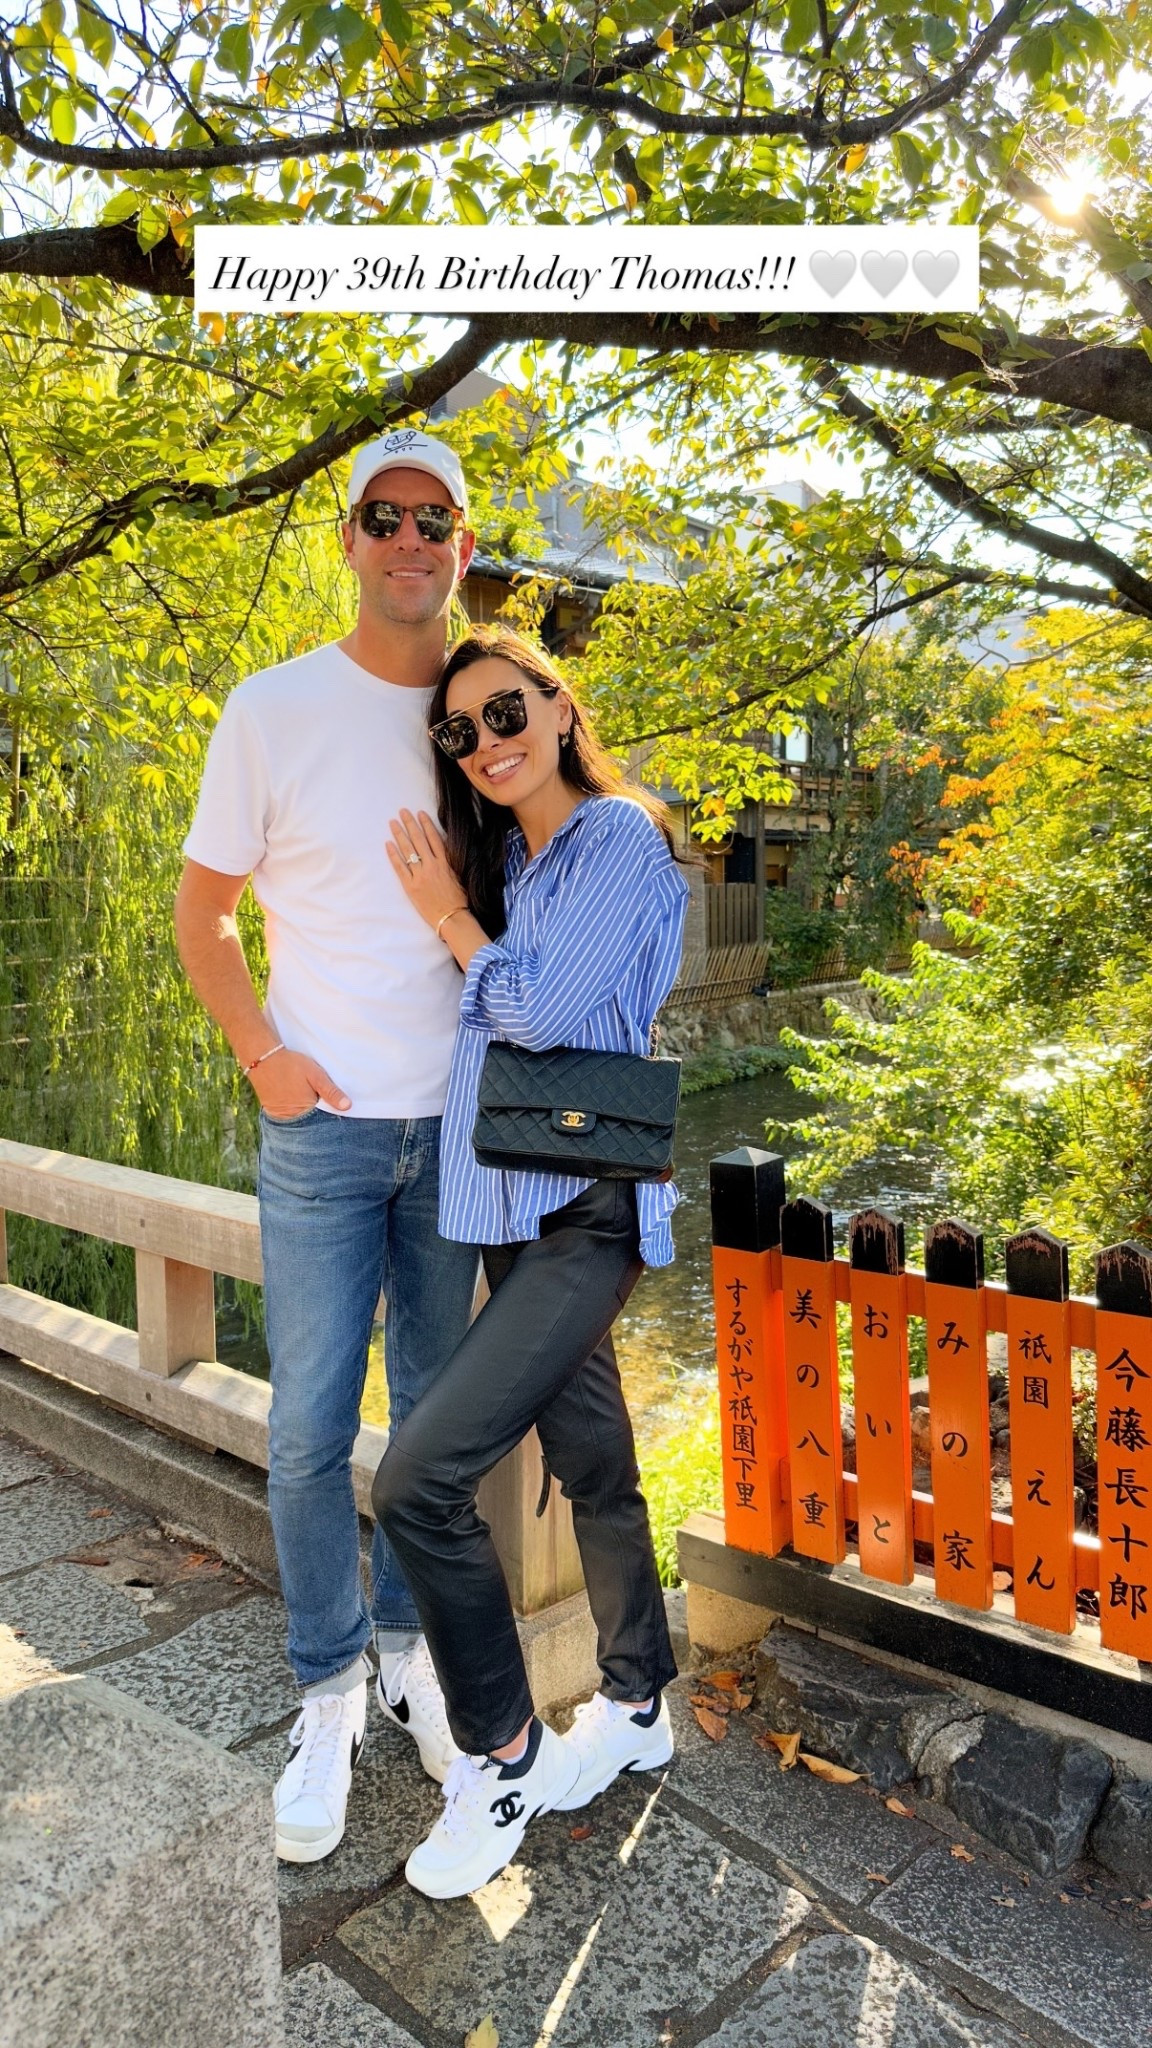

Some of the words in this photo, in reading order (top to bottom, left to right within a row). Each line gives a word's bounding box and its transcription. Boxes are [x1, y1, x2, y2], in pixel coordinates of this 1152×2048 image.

[725, 1278, 759, 1512] するがや祇園下里
[790, 1289, 830, 1528] 美の八重
[862, 1304, 893, 1544] おいと
[937, 1321, 976, 1571] みの家
[1017, 1330, 1055, 1591] 祇園えん
[1104, 1347, 1151, 1621] 今藤長十郎
